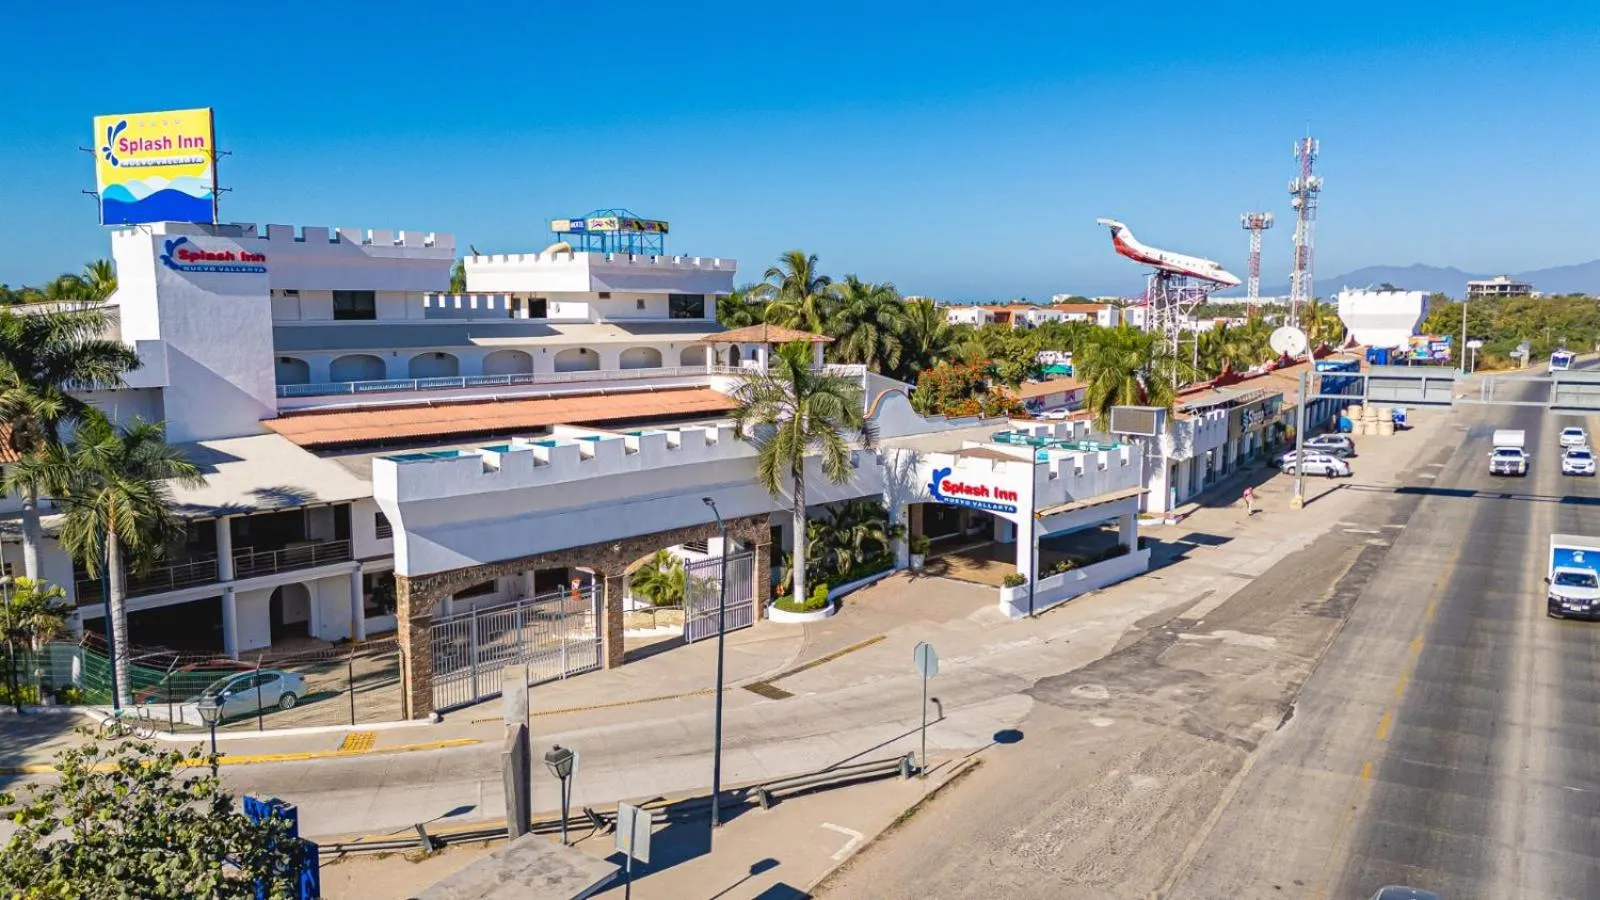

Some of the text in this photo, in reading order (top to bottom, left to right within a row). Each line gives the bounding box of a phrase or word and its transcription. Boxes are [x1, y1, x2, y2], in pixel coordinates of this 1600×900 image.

[119, 135, 204, 155] Splash Inn
[178, 249, 266, 262] Splash Inn
[942, 480, 1018, 502] Splash Inn
[973, 502, 1014, 512] VALLARTA
